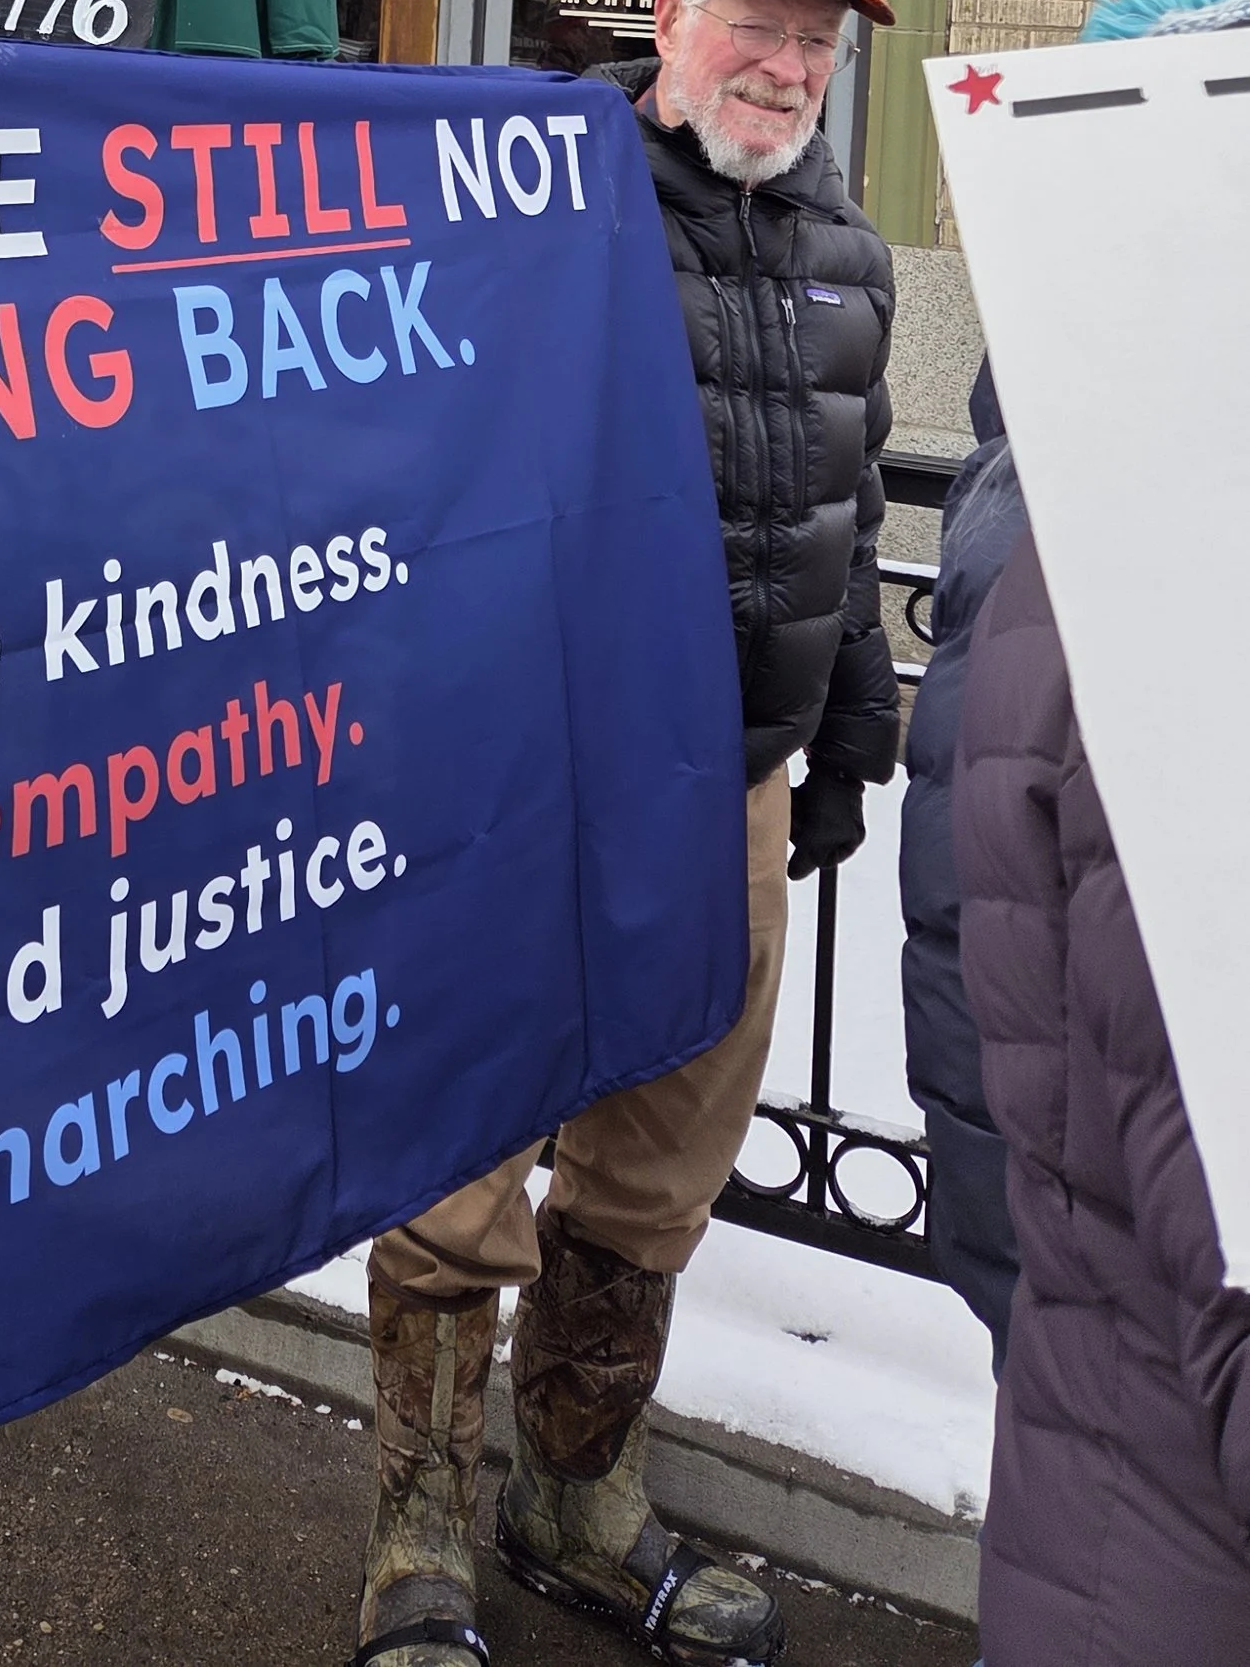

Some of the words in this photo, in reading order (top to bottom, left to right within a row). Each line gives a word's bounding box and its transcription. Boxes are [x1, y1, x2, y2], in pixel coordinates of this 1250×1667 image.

[100, 121, 407, 249] STILL
[436, 115, 587, 221] NOT
[173, 261, 475, 410] BACK.
[44, 527, 408, 681] kindness.
[101, 821, 406, 1018] justice.
[645, 1568, 678, 1631] YAKTRAX
